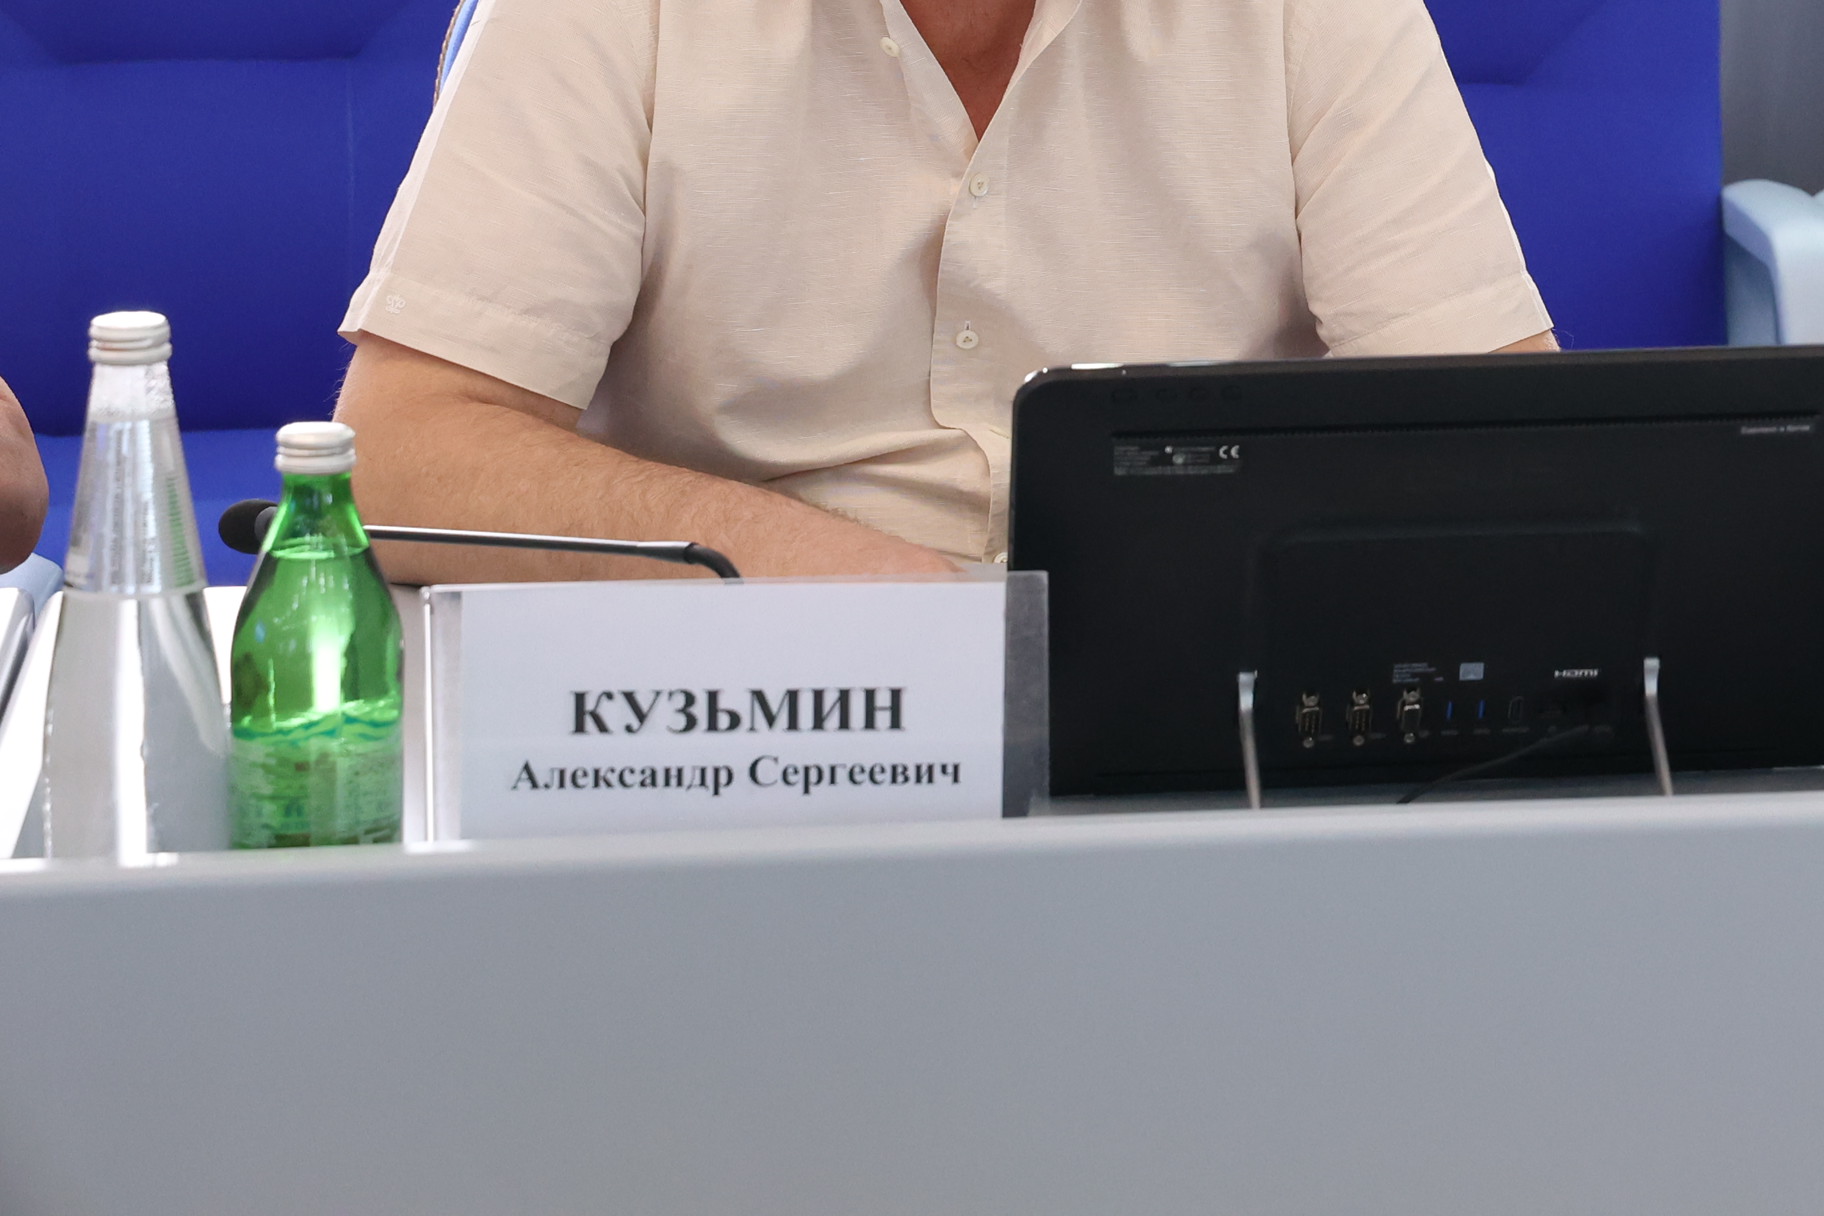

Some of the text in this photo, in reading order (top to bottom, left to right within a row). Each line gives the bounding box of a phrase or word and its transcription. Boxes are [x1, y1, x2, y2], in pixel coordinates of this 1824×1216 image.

[570, 687, 906, 735] КУЗЬМИН
[512, 756, 961, 797] Александр Сергеевич
